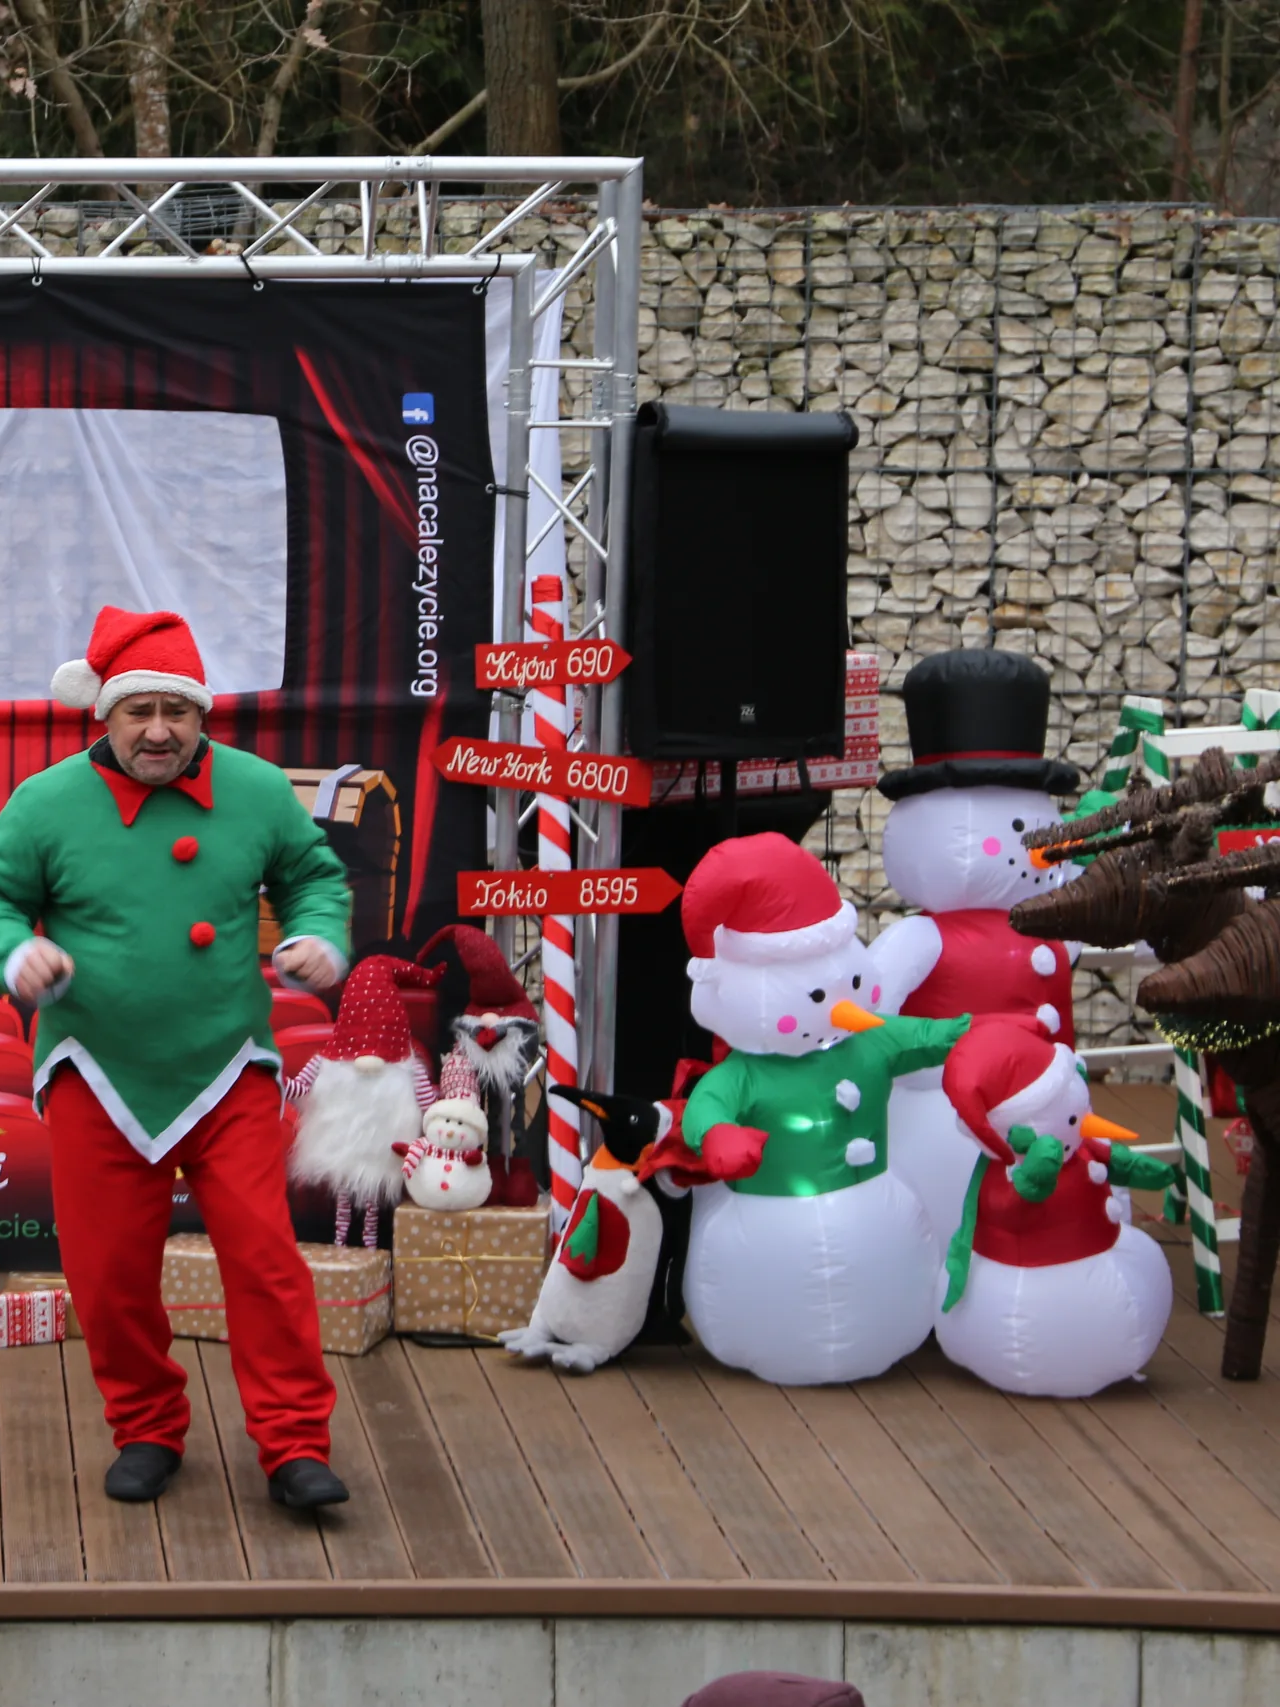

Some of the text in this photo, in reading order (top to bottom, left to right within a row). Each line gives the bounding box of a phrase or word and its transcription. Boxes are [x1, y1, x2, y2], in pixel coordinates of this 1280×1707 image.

[406, 434, 444, 697] @nacalezycie.org
[567, 645, 613, 676] 690
[567, 760, 629, 796] 6800
[470, 877, 638, 910] Tokio 8595
